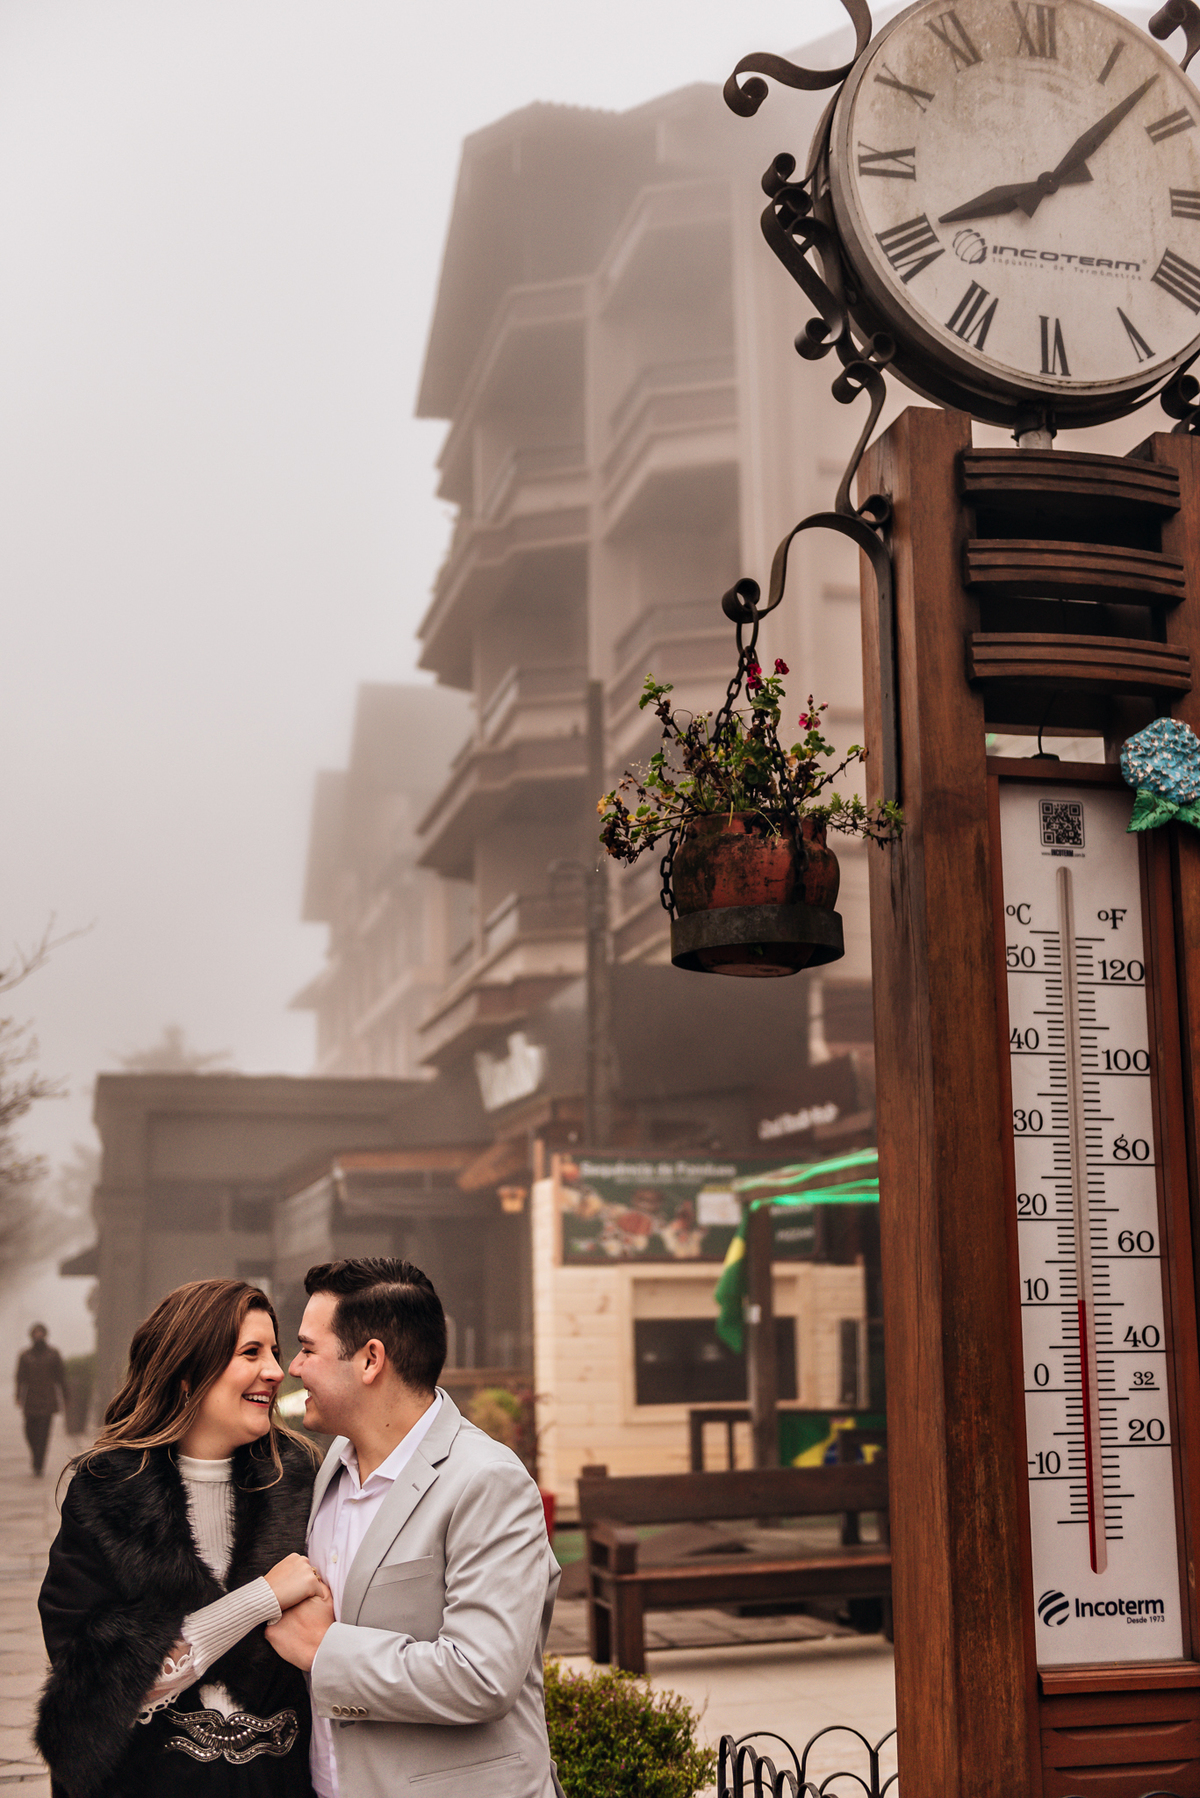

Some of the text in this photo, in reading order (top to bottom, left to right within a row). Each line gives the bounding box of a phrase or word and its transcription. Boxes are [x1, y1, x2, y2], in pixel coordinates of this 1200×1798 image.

[924, 10, 983, 73] XI
[1011, 1, 1057, 59] XII
[1097, 39, 1125, 85] I
[874, 63, 935, 112] X
[1144, 106, 1197, 145] II
[858, 141, 917, 182] IX
[875, 213, 946, 285] VIII
[945, 280, 999, 351] VII
[1039, 315, 1071, 377] VI
[1116, 306, 1156, 363] V
[1006, 944, 1036, 968] 50
[1098, 959, 1145, 982] 120
[1009, 1027, 1040, 1050] 40
[1102, 1049, 1150, 1072] 100
[1013, 1109, 1044, 1132] 30
[1112, 1134, 1150, 1161] 80
[1017, 1193, 1048, 1216] 20
[1117, 1230, 1155, 1253] 60
[1023, 1278, 1049, 1301] 10
[1123, 1325, 1160, 1348] 40
[1033, 1363, 1050, 1387] 0
[1132, 1371, 1155, 1386] 32
[1128, 1418, 1165, 1442] 20
[1027, 1450, 1061, 1475] -10
[1074, 1598, 1165, 1618] Incoterm
[1126, 1615, 1166, 1625] Desde 1973
